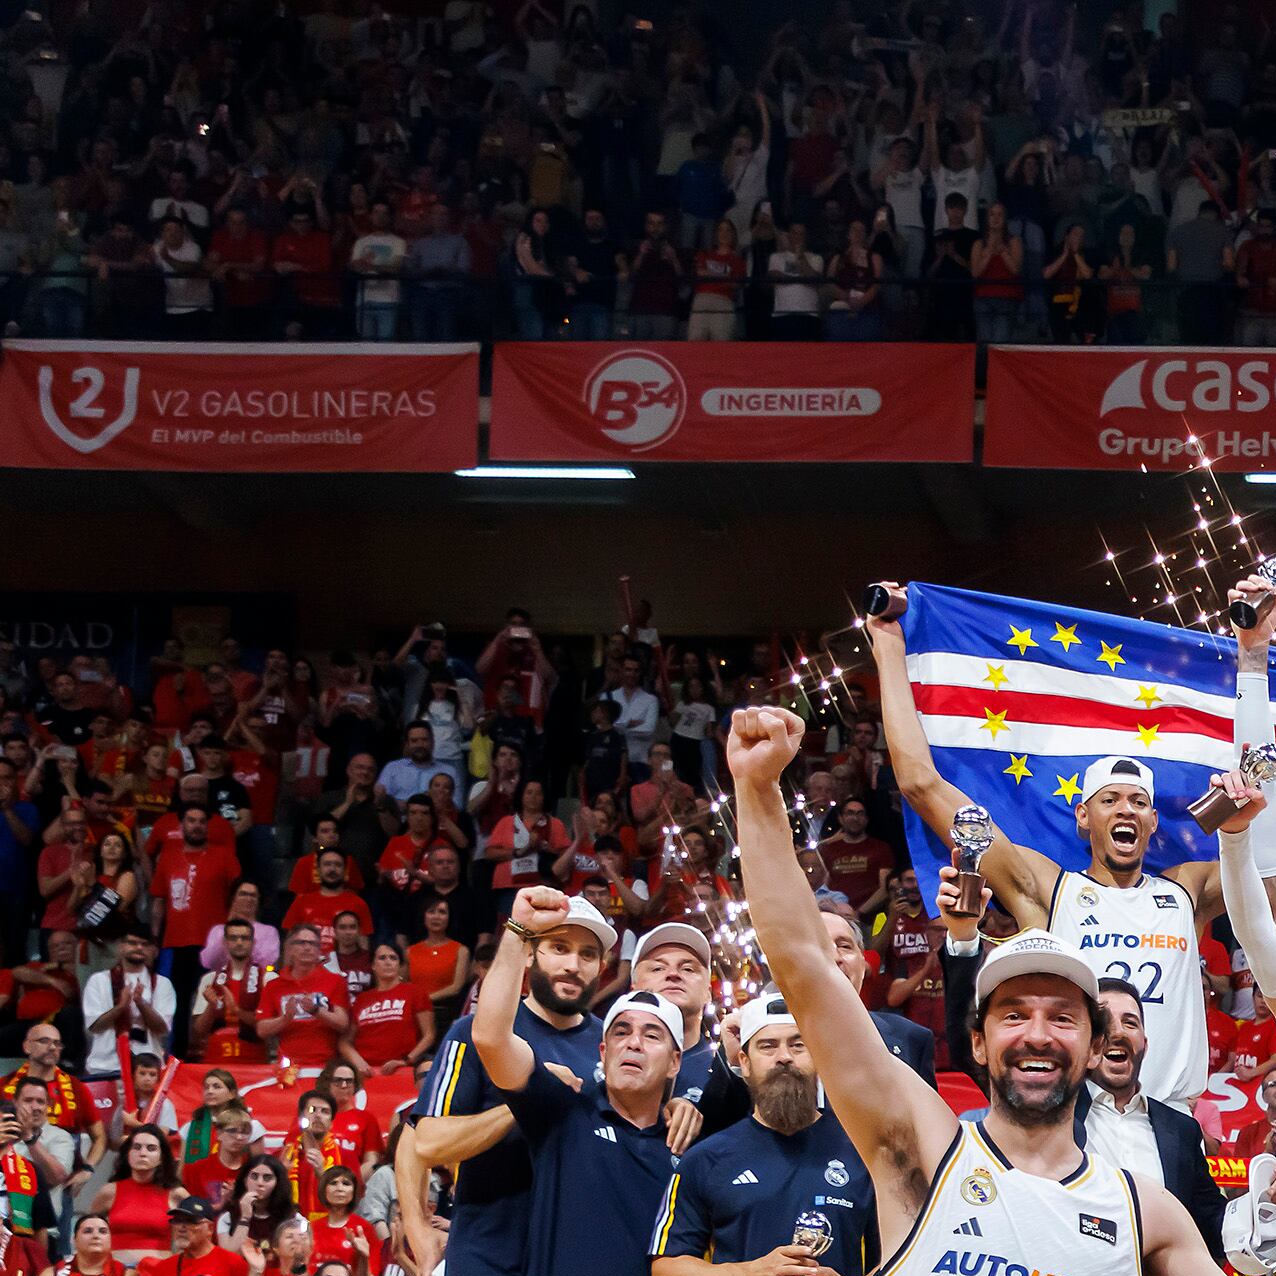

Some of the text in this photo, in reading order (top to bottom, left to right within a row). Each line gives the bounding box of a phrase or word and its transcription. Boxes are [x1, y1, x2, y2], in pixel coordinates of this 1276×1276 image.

[152, 390, 437, 418] V2 GASOLINERAS
[719, 391, 862, 412] INGENIERÍA
[151, 430, 363, 444] El MVP del Combustible
[1099, 428, 1206, 463] Grupo
[1080, 934, 1187, 952] AUTOHERO
[826, 1195, 854, 1209] Sanitas
[1081, 1218, 1098, 1229] liga
[1081, 1226, 1116, 1243] endesa
